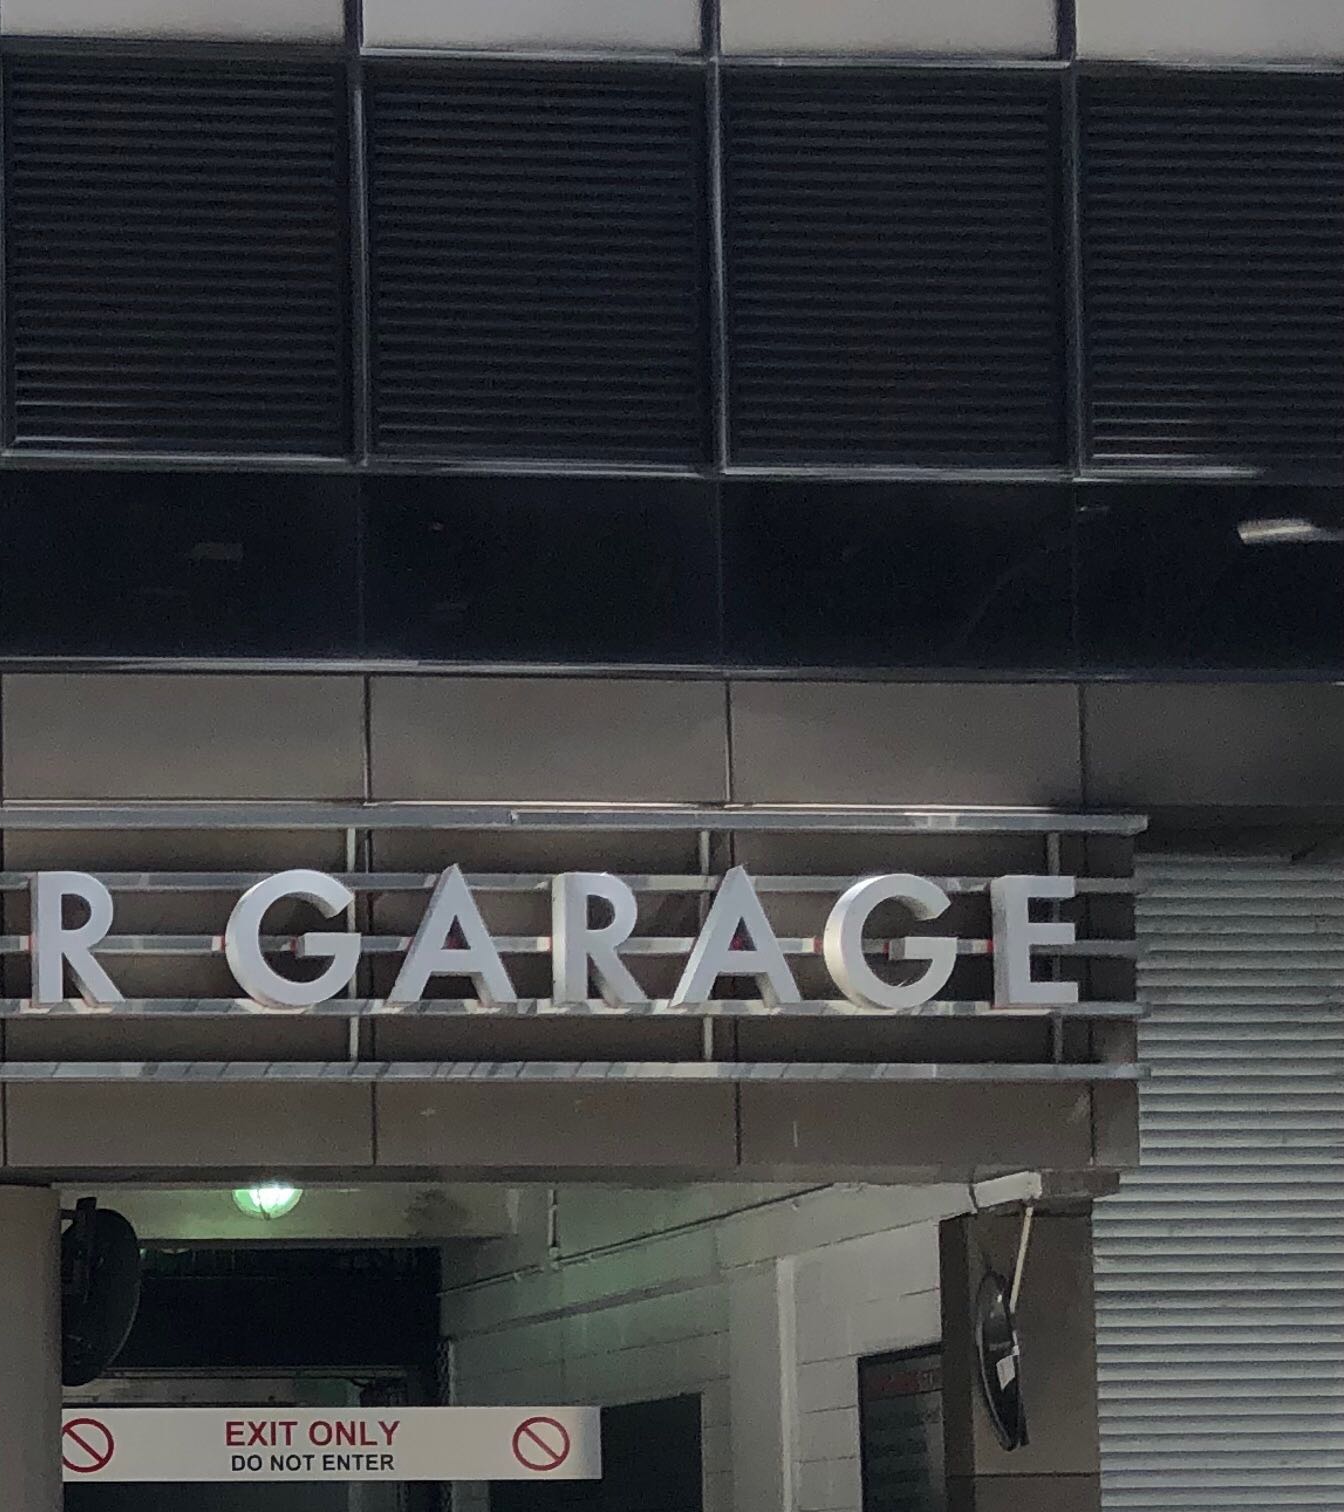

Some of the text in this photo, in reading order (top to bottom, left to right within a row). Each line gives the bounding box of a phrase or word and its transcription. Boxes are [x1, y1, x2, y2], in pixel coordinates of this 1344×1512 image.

[223, 863, 1079, 1010] GARAGE
[225, 1420, 400, 1447] EXIT ONLY
[231, 1453, 395, 1472] DO NOT ENTER
